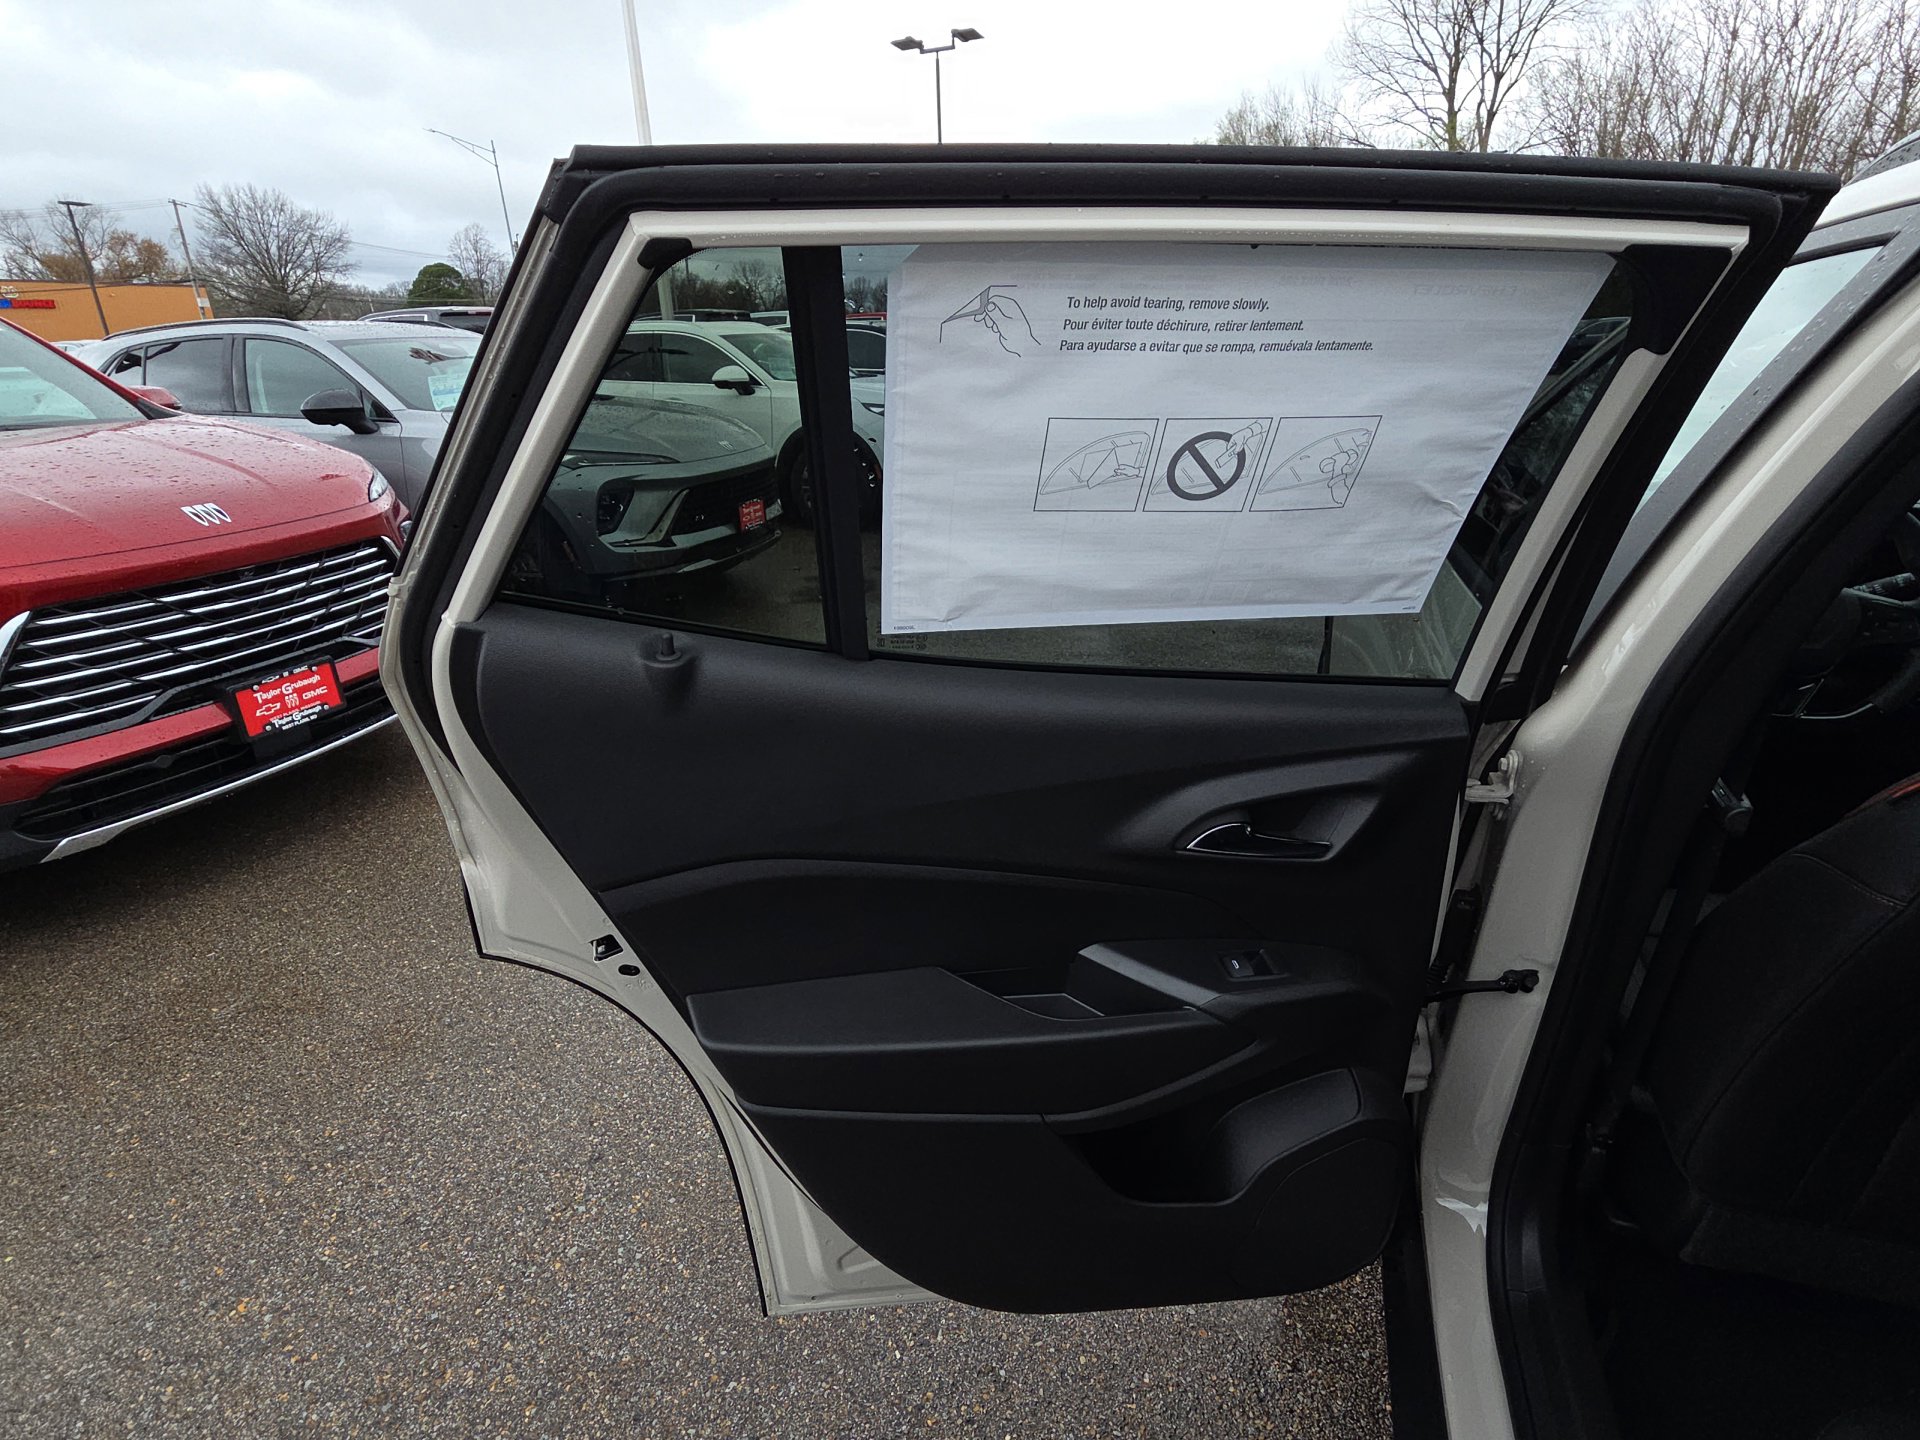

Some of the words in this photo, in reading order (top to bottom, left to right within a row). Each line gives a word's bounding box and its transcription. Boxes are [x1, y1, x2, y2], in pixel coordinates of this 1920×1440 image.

[1067, 296, 1081, 309] To
[1083, 296, 1108, 311] help
[1110, 296, 1141, 309] avoid
[1143, 297, 1186, 312] tearing,
[1188, 299, 1229, 310] remove
[1232, 298, 1270, 312] slowly.
[1063, 318, 1089, 331] Pour
[1091, 317, 1123, 331] éviter
[1125, 318, 1154, 331] toute
[1156, 319, 1211, 333] déchirure,
[1213, 320, 1249, 332] retirer
[1249, 320, 1305, 332] lentement.
[1059, 339, 1085, 351] Para
[1087, 339, 1137, 352] ayudarse
[1139, 342, 1147, 352] a
[1149, 341, 1181, 352] evitar
[1182, 343, 1203, 355] que
[1204, 343, 1218, 353] se
[1220, 343, 1256, 355] rompa,
[1258, 340, 1313, 352] remuévala
[1314, 340, 1374, 352] lentamente.
[252, 688, 282, 704] Taylor
[281, 674, 321, 695] Grubaugh
[302, 685, 328, 700] GMC
